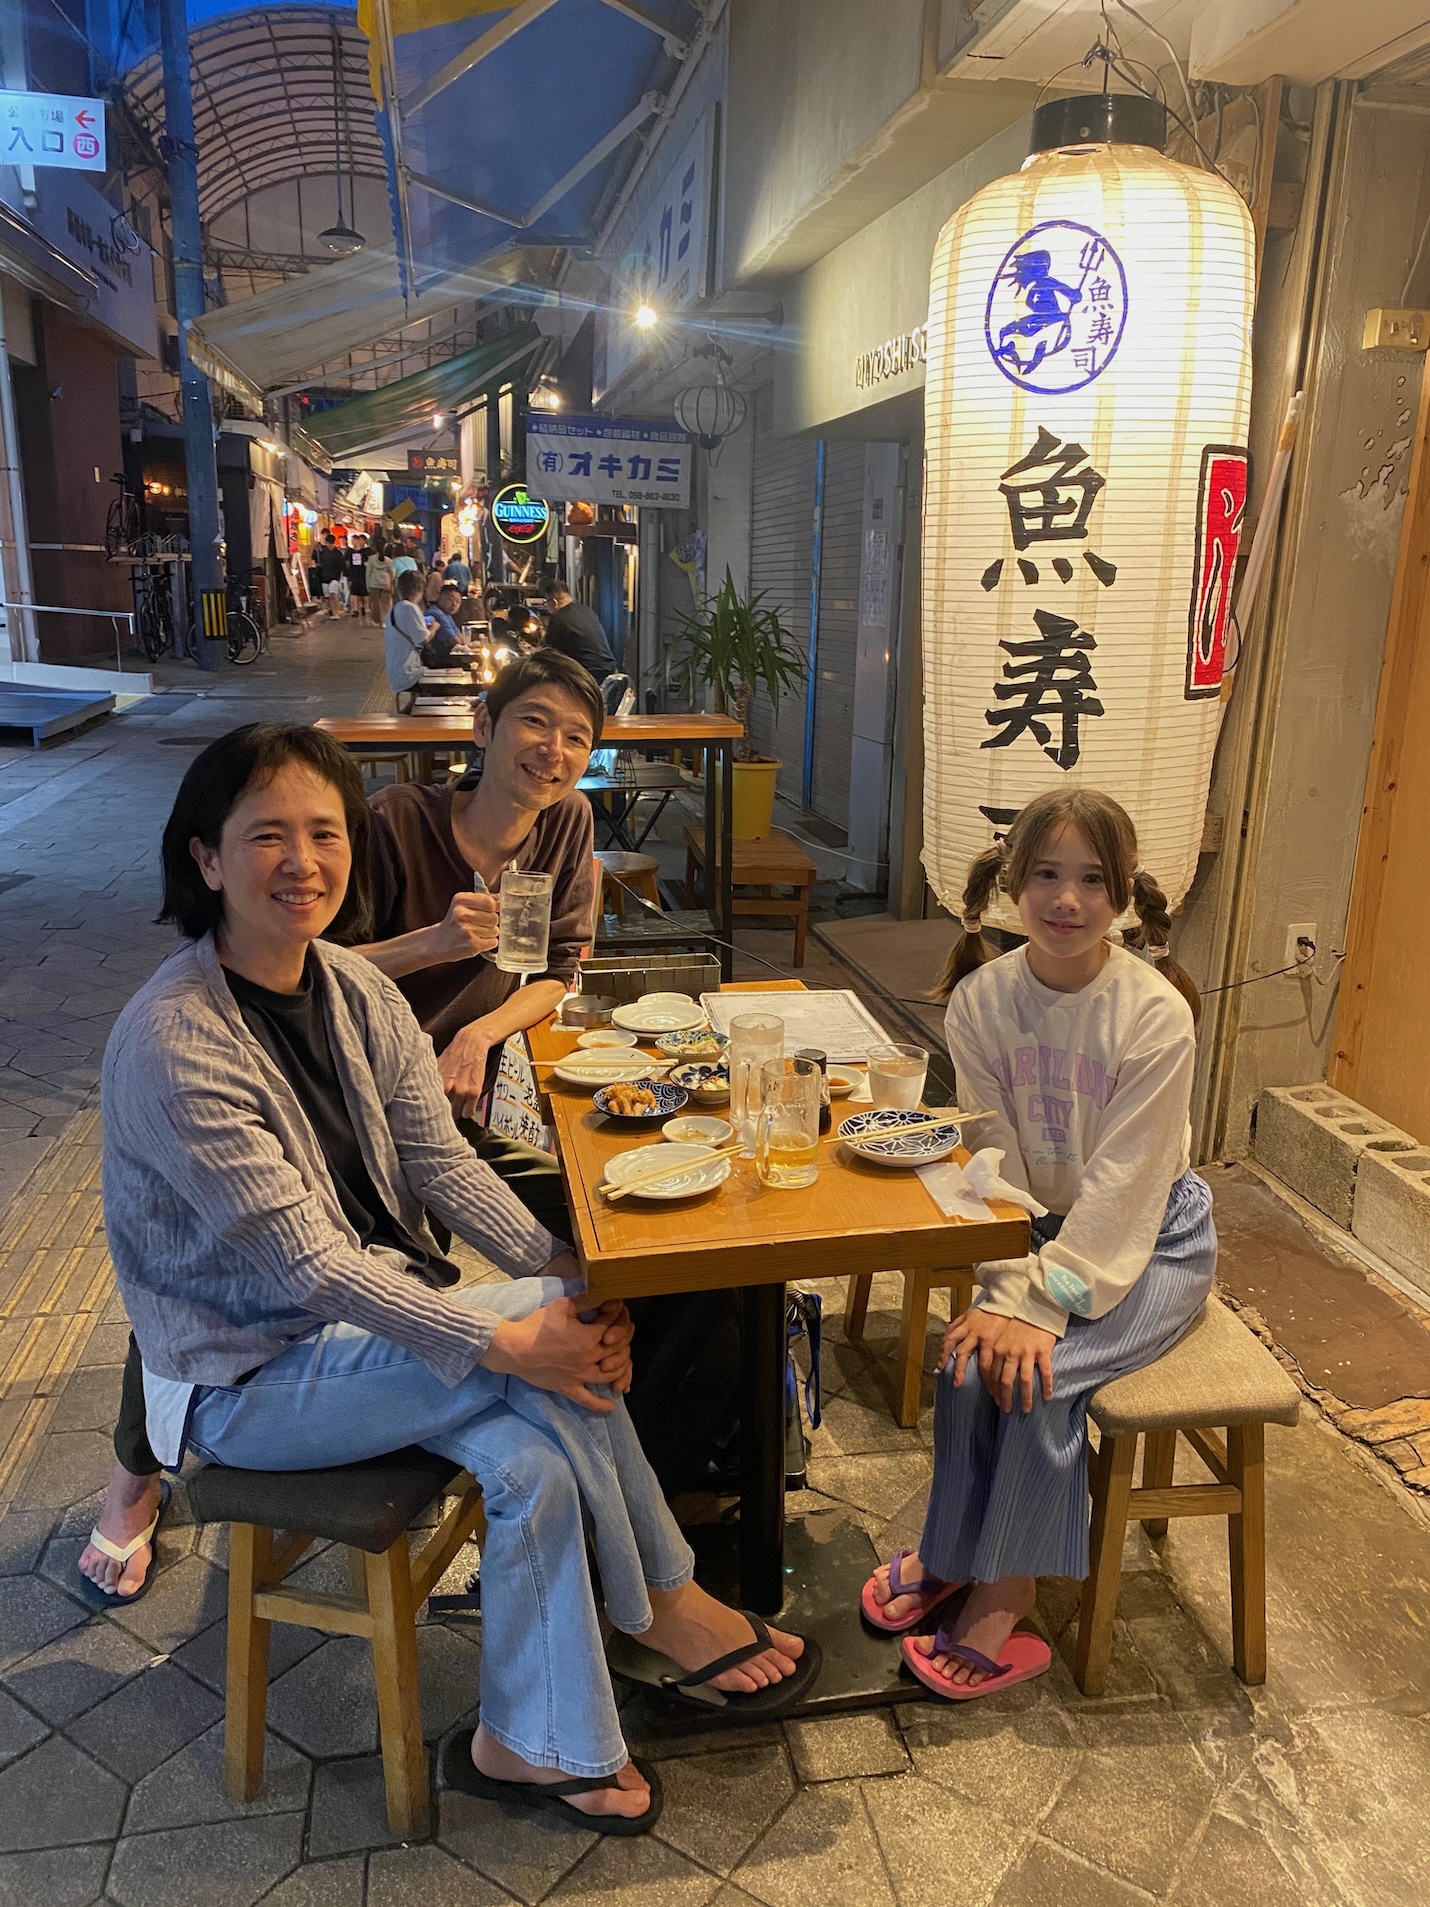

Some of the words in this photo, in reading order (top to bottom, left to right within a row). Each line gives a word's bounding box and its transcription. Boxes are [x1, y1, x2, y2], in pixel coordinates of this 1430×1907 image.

[8, 105, 64, 123] 公市場
[8, 126, 64, 153] 入口
[76, 135, 97, 156] 西
[1071, 275, 1115, 379] 魚寿司
[494, 503, 547, 520] GUINNESS
[979, 425, 1118, 843] 魚寿
[1028, 1094, 1074, 1129] CITY
